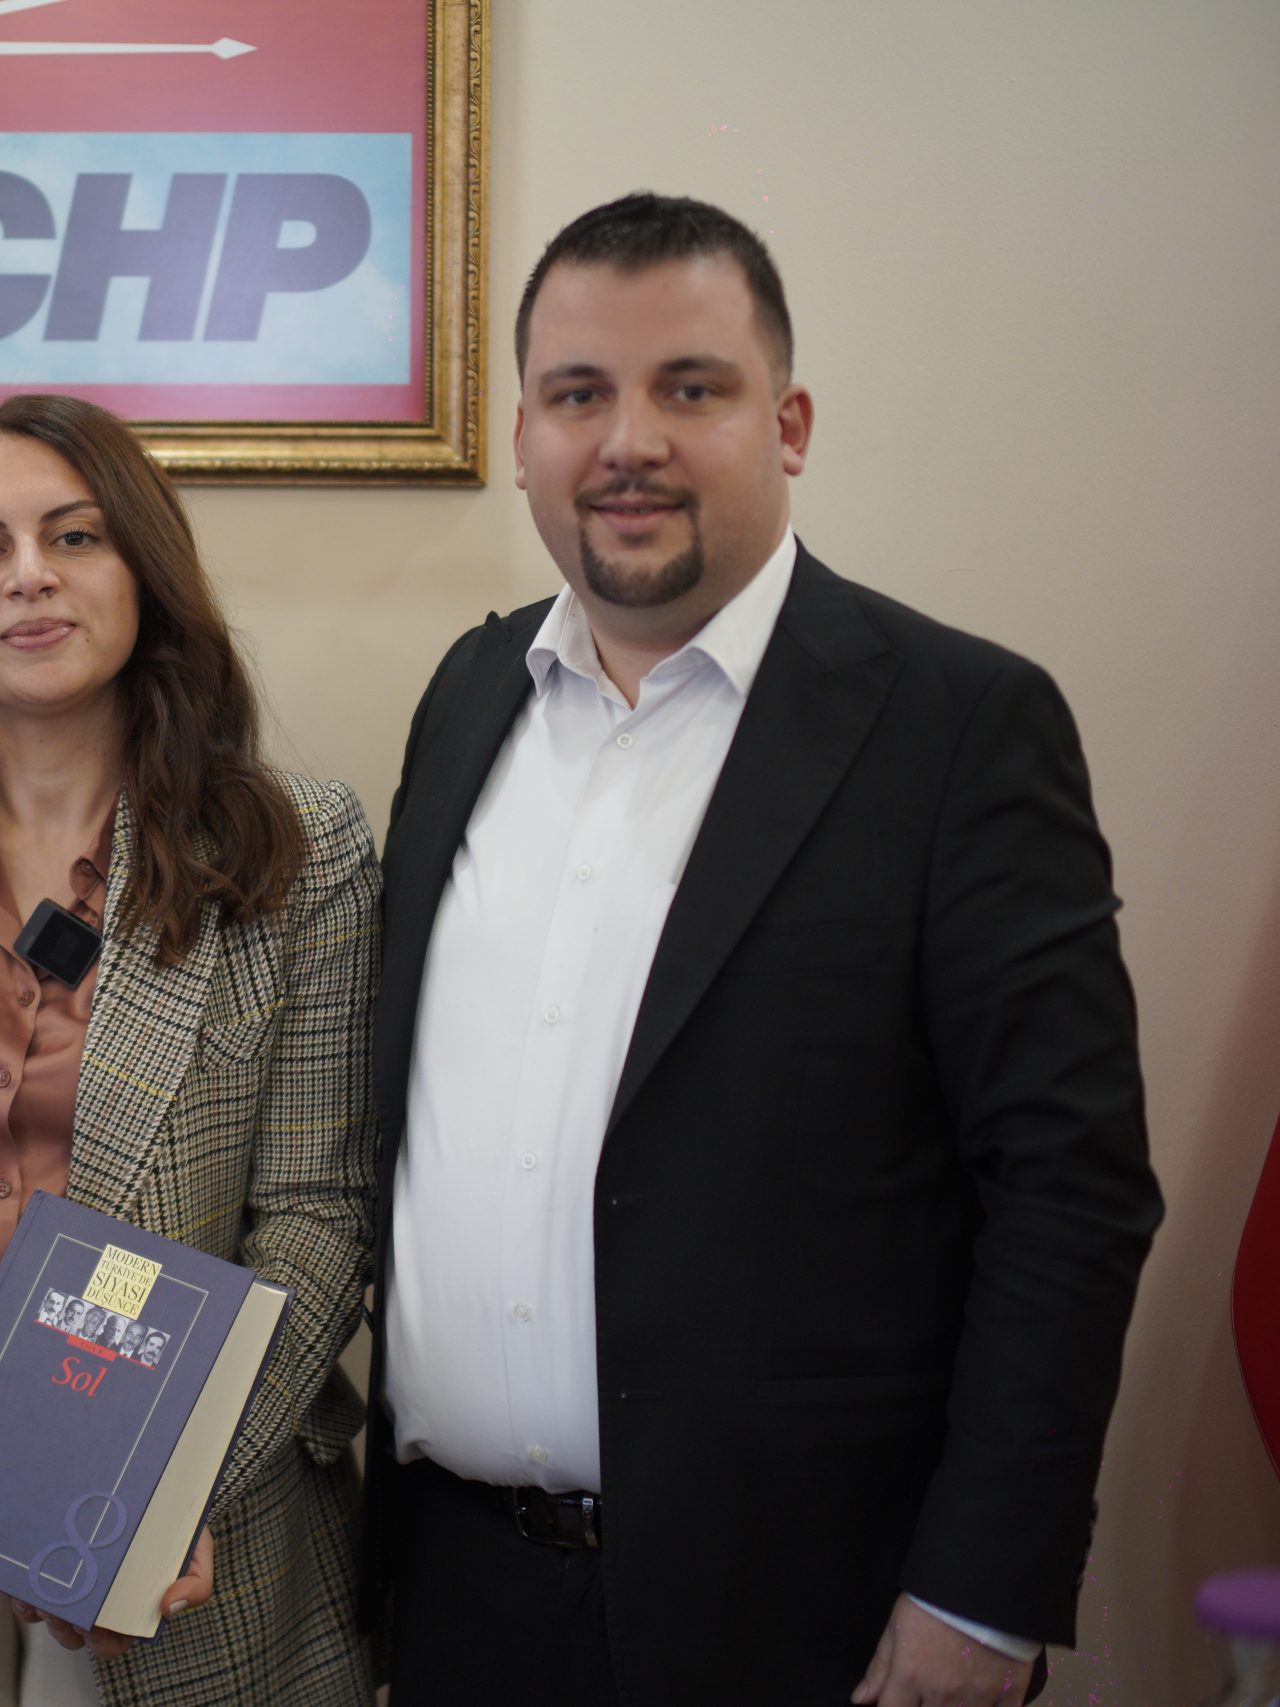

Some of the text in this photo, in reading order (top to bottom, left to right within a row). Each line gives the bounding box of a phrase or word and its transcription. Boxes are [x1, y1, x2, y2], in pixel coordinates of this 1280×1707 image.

[105, 1247, 161, 1275] MODERN
[87, 1287, 139, 1316] DÜŞÜNCE
[51, 1356, 108, 1399] Sol
[29, 1491, 128, 1606] 8
